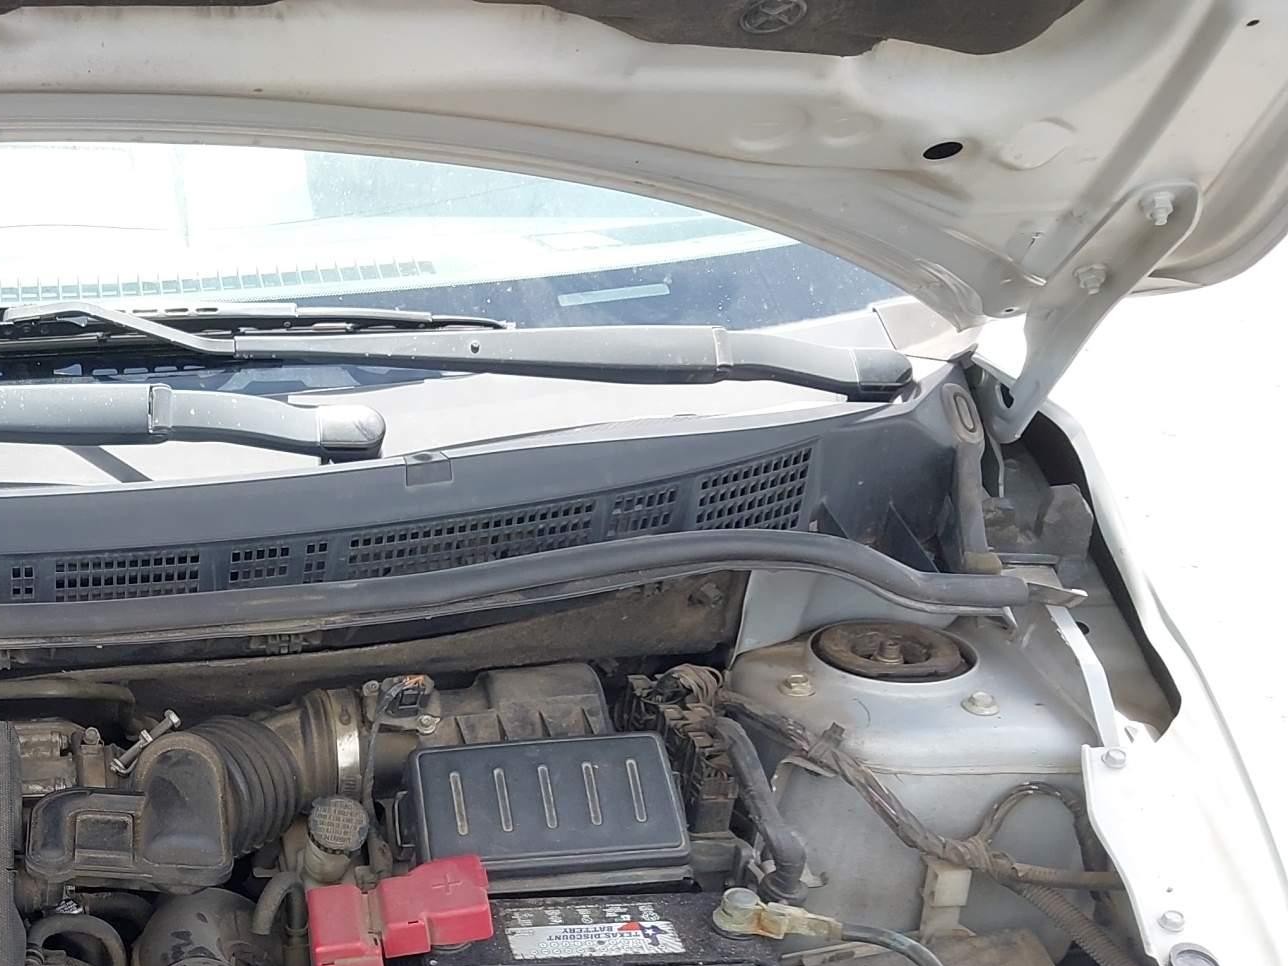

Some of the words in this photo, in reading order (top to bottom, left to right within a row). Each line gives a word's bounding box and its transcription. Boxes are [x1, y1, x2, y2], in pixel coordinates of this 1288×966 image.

[561, 926, 614, 934] BATTERY
[546, 932, 602, 941] DISCOUNT
[605, 931, 641, 940] TEXAS
